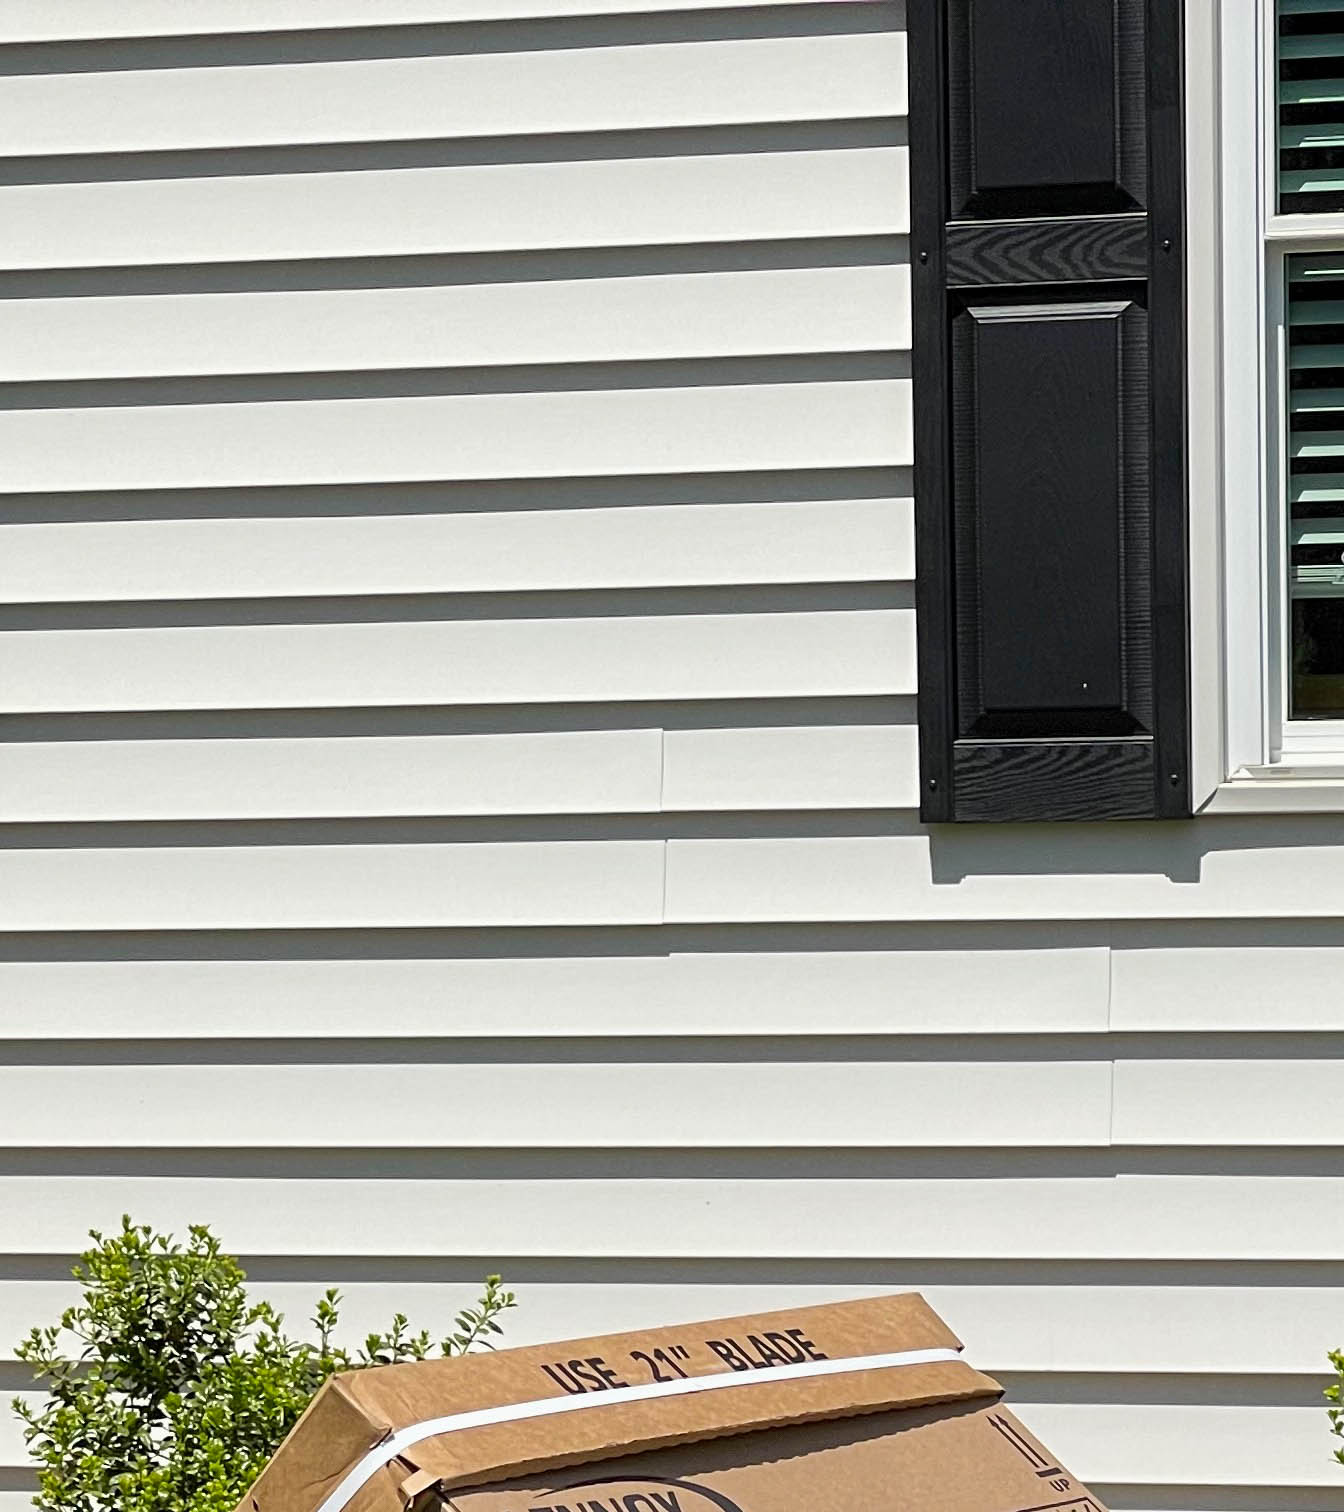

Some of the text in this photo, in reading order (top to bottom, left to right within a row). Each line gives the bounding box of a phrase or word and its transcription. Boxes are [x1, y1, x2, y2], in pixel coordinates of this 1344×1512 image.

[541, 1328, 829, 1395] USE 21" BLADE
[1049, 1479, 1071, 1492] UP
